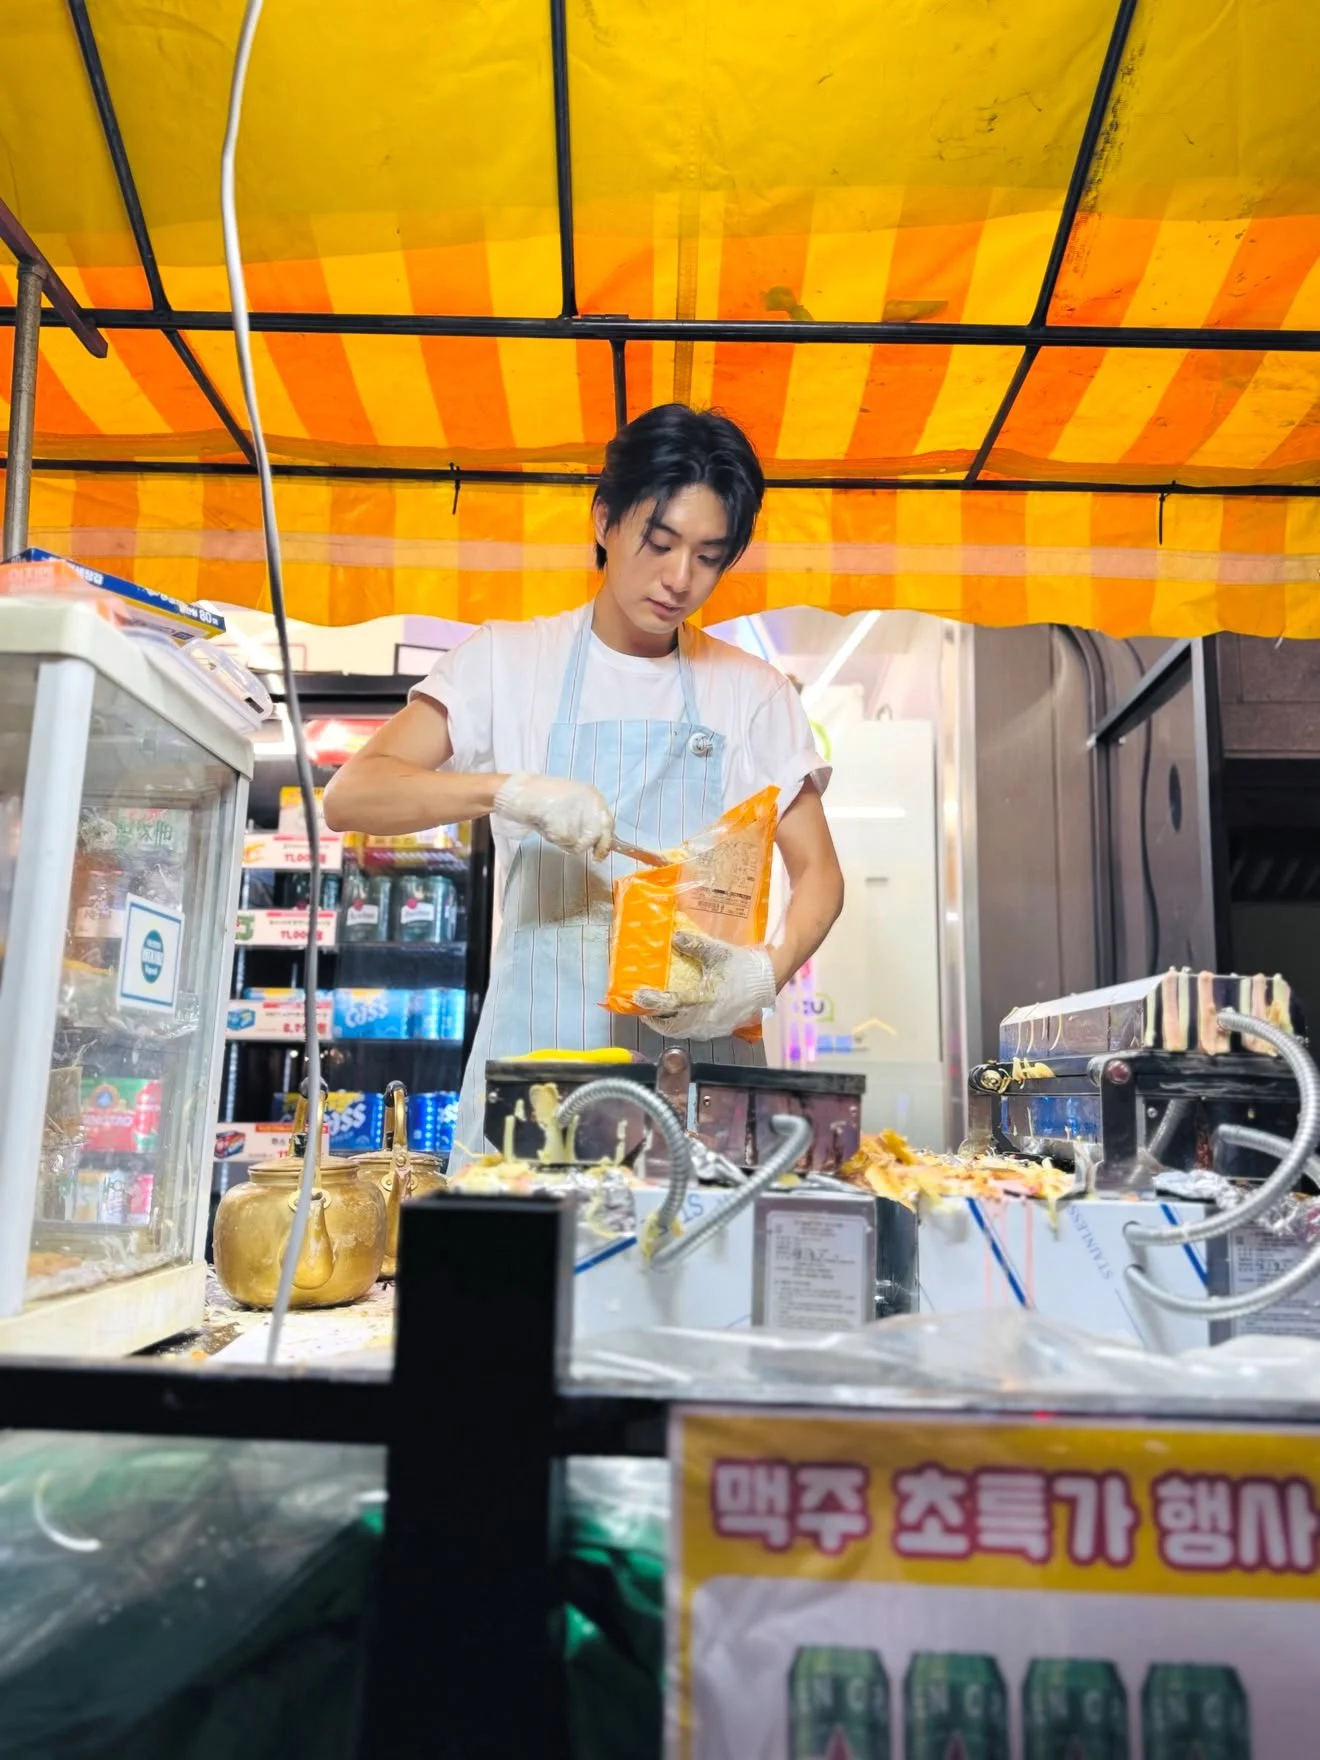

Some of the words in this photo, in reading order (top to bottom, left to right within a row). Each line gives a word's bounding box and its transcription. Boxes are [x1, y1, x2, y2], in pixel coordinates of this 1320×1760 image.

[712, 1459, 868, 1553] 맥주
[894, 1463, 1138, 1566] 초특가
[1153, 1469, 1320, 1571] 행사
